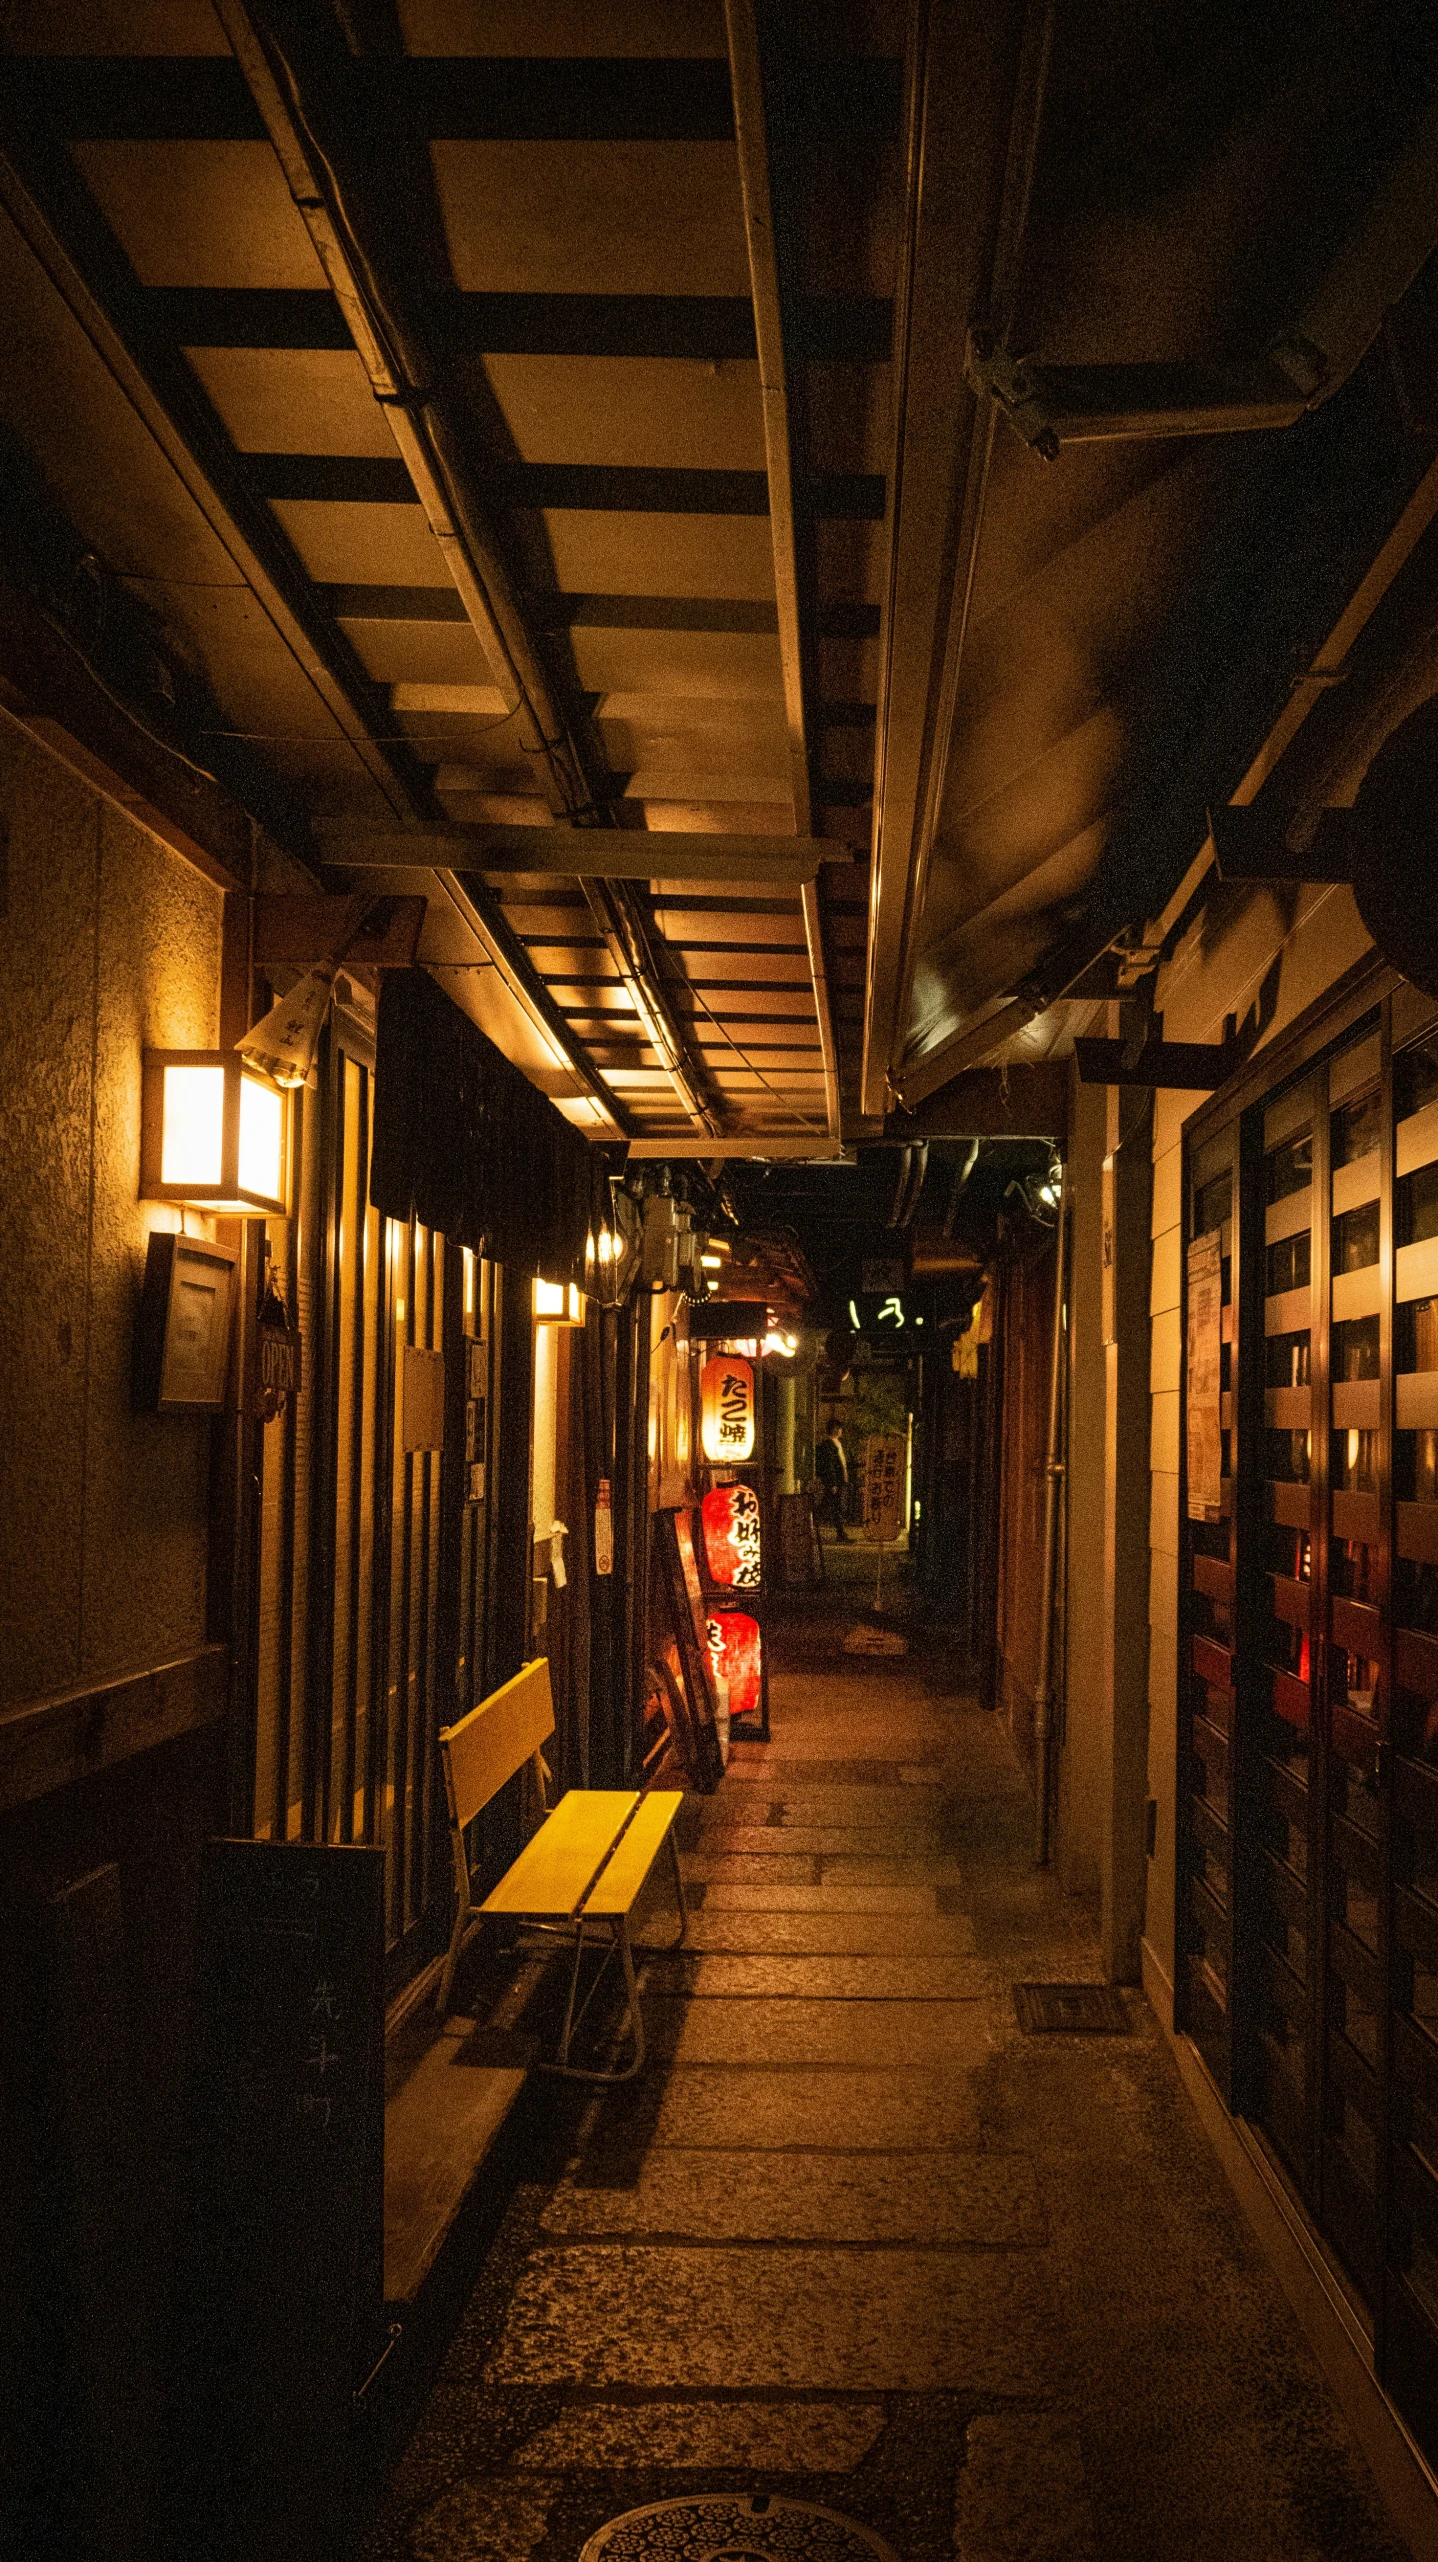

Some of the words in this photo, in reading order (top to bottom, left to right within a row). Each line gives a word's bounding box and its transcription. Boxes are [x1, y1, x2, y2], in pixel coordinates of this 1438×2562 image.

[262, 1341, 294, 1388] OPEN
[720, 1374, 748, 1443] たこ焼
